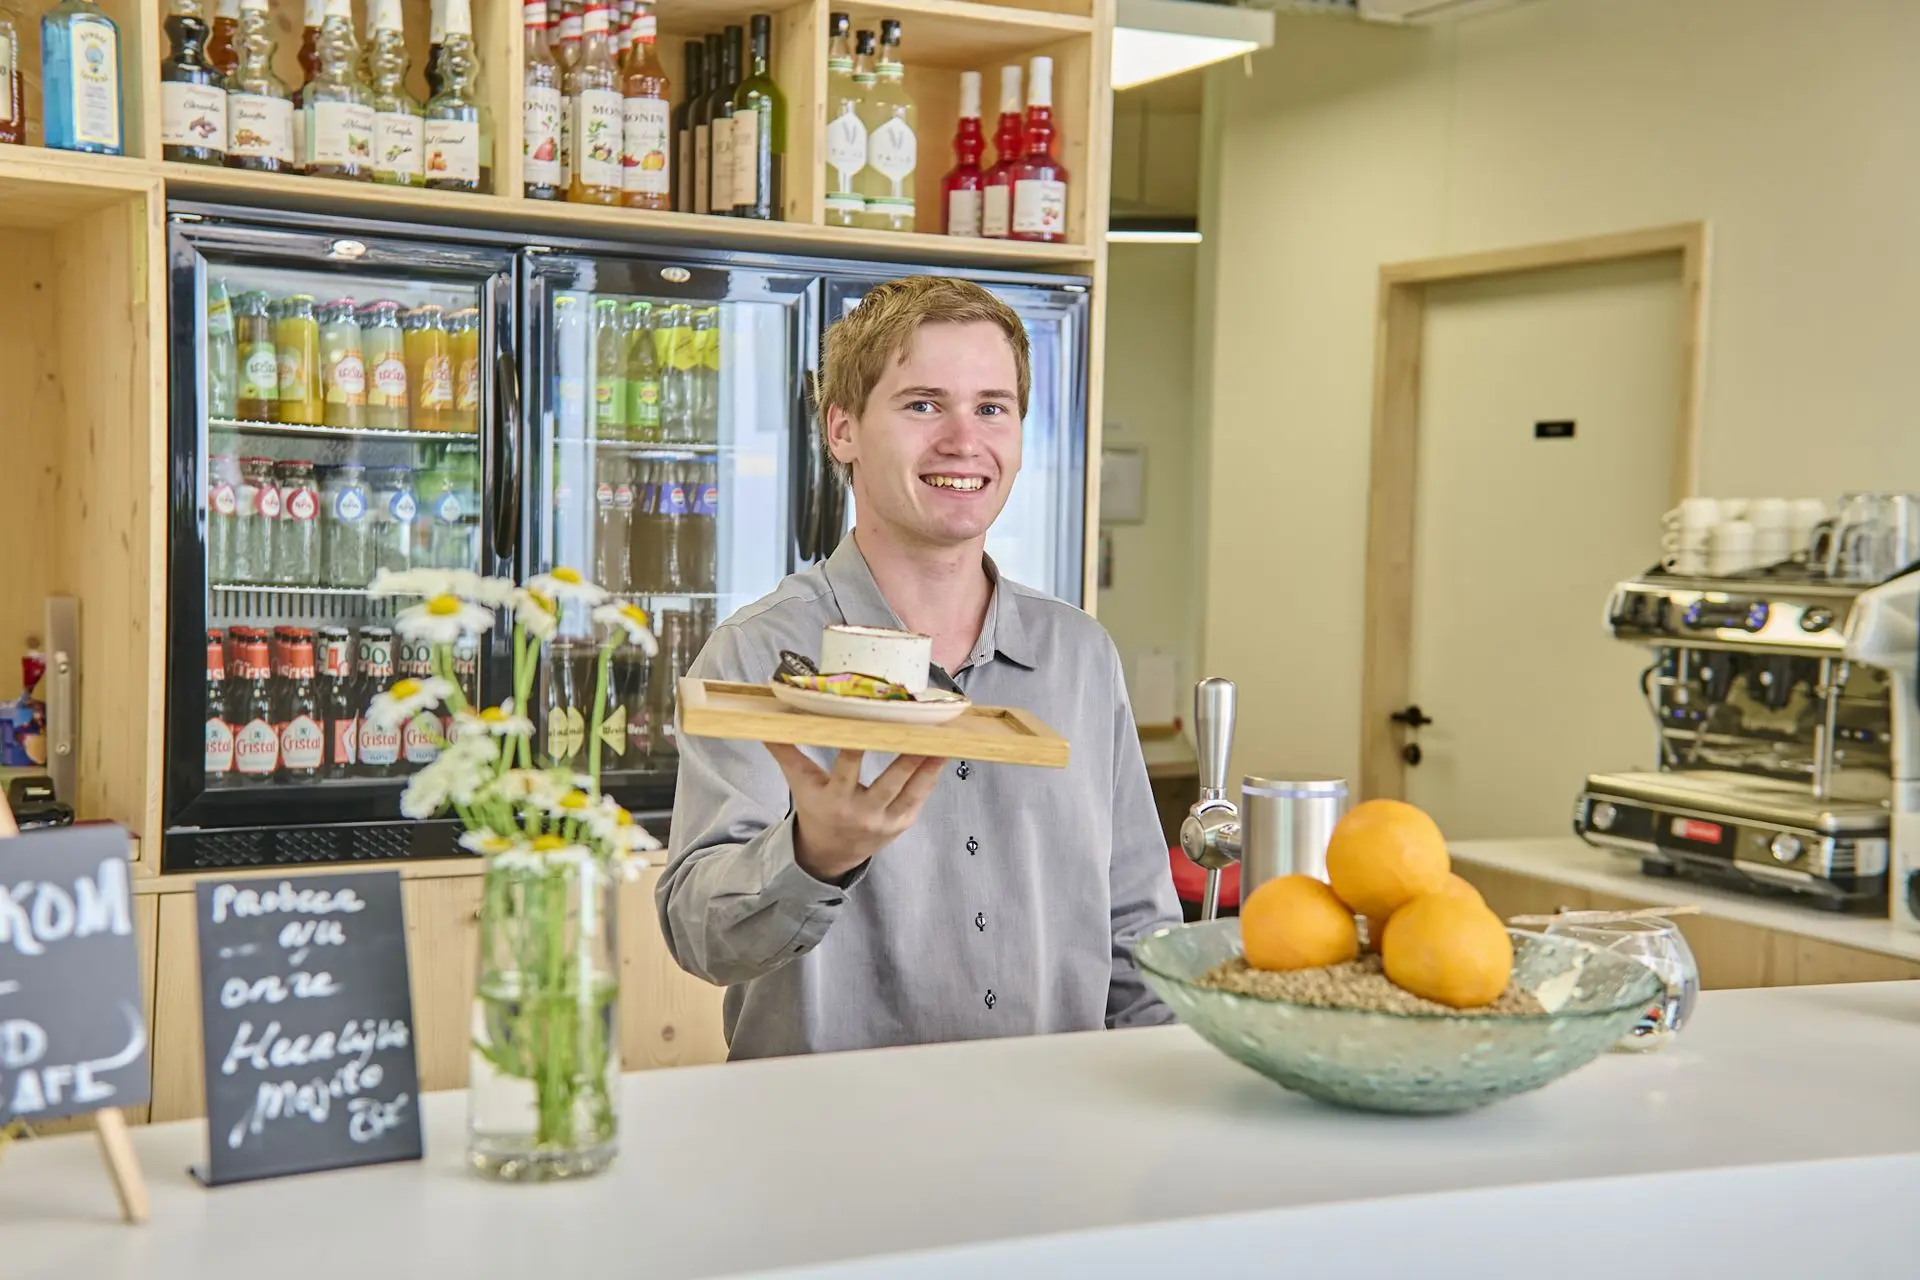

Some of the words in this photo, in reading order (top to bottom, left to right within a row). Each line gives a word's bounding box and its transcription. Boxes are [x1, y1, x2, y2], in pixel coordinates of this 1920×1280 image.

[524, 101, 558, 113] ONIN
[236, 738, 276, 757] Cristal
[282, 734, 320, 753] Cristal
[361, 731, 397, 749] Cristal
[6, 1062, 118, 1113] AFE
